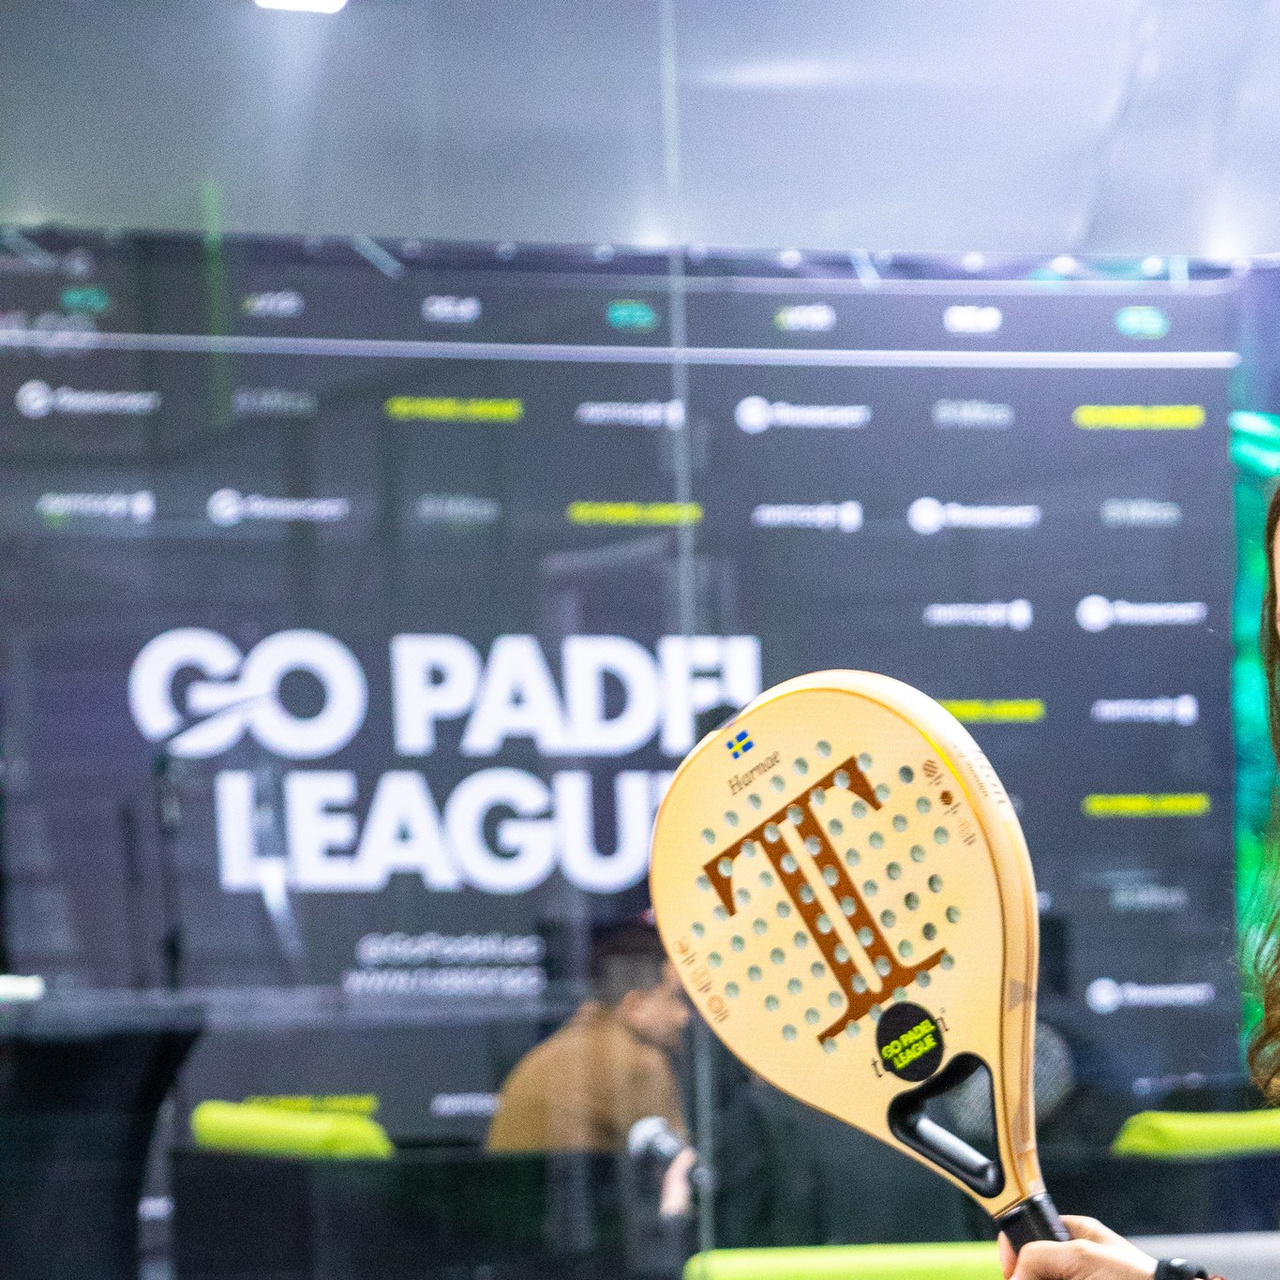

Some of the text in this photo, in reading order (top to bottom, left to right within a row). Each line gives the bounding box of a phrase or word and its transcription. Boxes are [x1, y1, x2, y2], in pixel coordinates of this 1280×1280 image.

[127, 627, 369, 761] GO
[213, 768, 676, 895] LEAGU
[881, 1040, 902, 1059] GO
[899, 1019, 935, 1047] PADEL
[893, 1034, 937, 1070] LEAGUE
